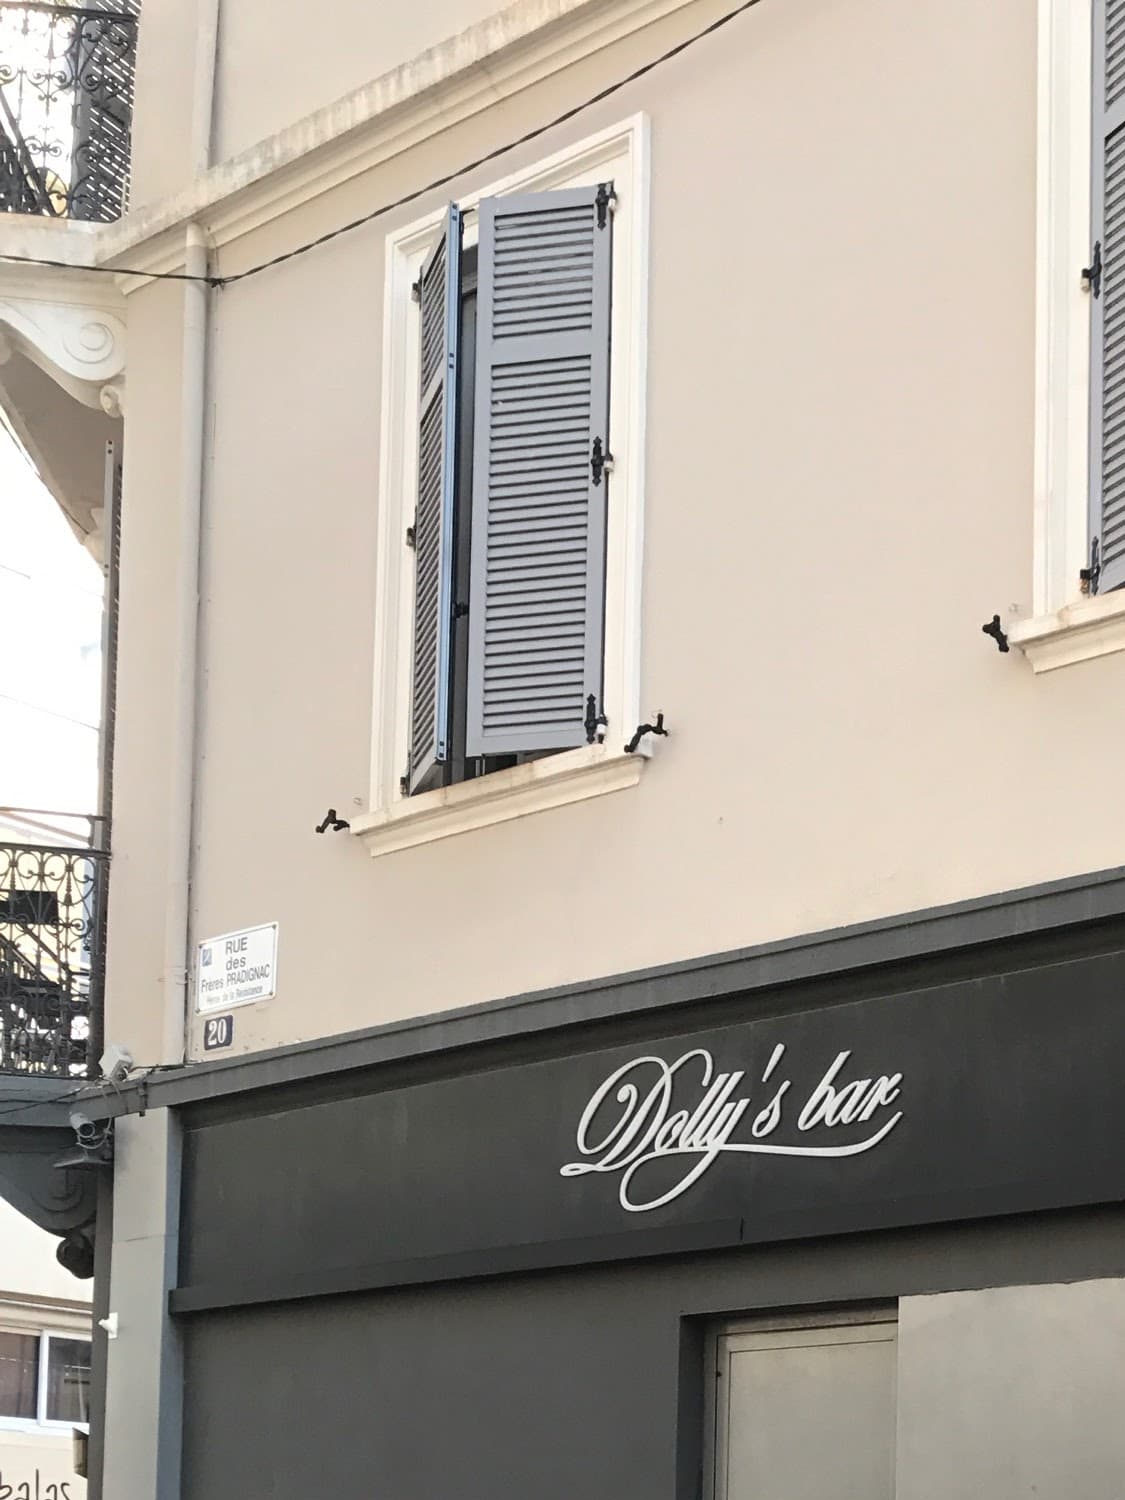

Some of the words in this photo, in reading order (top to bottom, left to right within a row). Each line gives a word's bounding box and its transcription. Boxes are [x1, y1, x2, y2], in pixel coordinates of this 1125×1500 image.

[225, 936, 248, 955] RUE
[225, 956, 247, 971] des
[226, 963, 271, 987] PRADIGNAC
[207, 1018, 227, 1046] 20
[560, 1043, 792, 1212] Dolly's
[797, 1049, 903, 1132] bar
